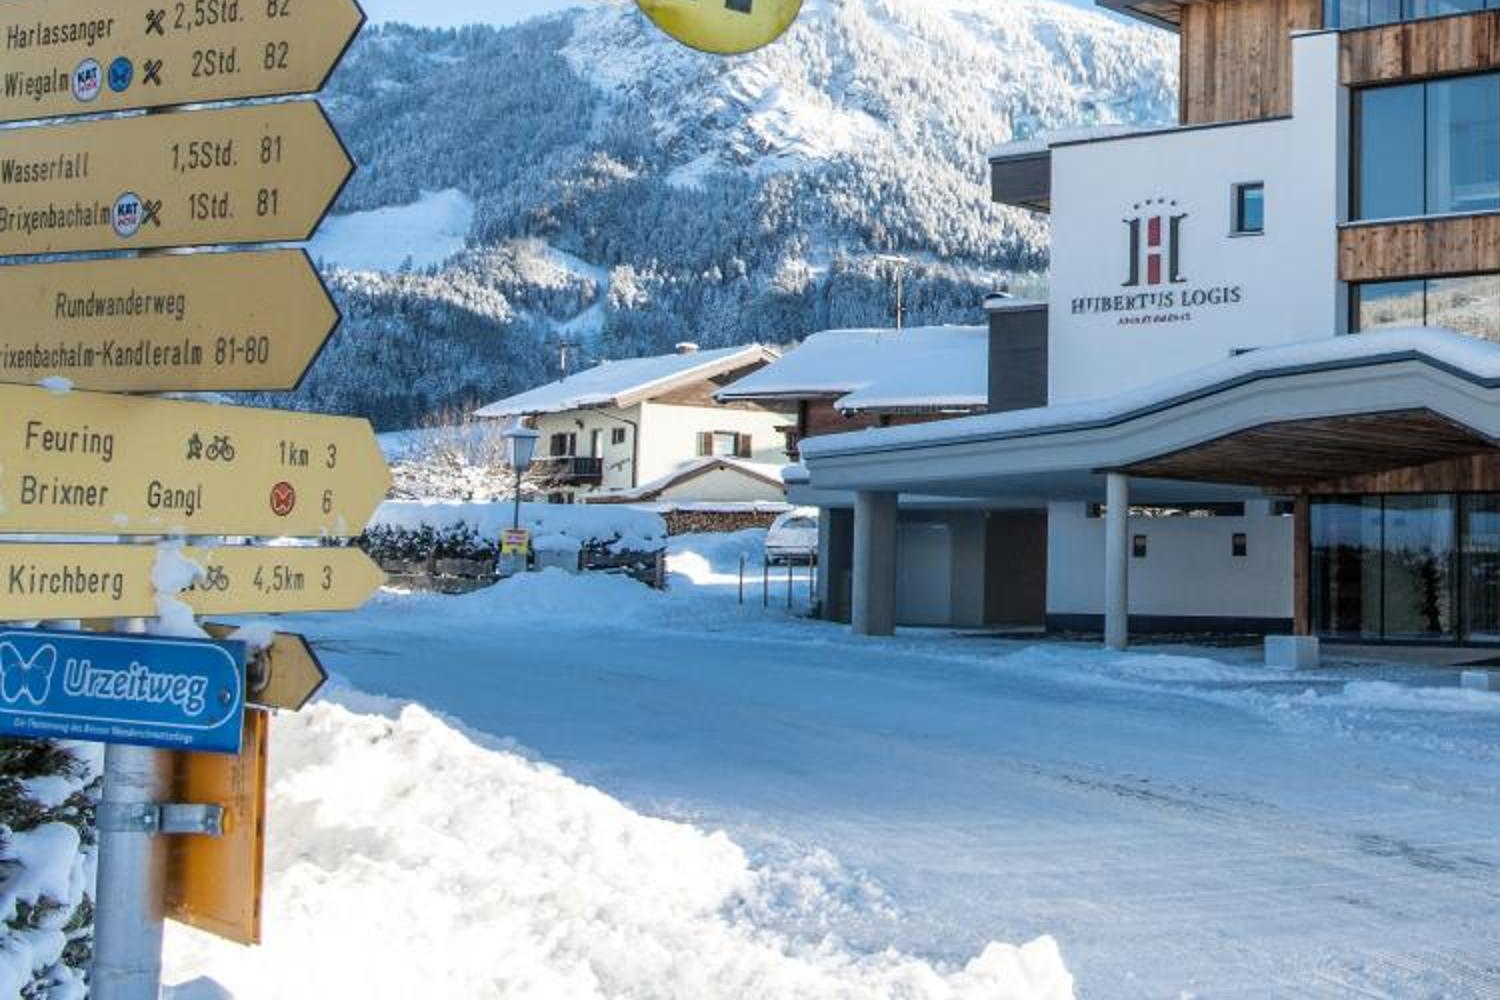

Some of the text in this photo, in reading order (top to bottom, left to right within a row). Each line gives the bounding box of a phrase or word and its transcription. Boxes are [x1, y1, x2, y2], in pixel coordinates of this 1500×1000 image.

[7, 17, 115, 49] Harlassanger
[191, 48, 241, 77] 2Std.
[264, 41, 289, 70] 82
[1, 135, 282, 184] Wasserfall 1,5Std. 81
[117, 202, 138, 216] KAT
[188, 193, 234, 220] 1Std.
[257, 188, 279, 217] 81
[54, 289, 186, 321] Rundwanderweg
[1071, 286, 1242, 315] HUBERTUS LOGIS
[0, 336, 269, 370] ixenbachalm-Kandleralm 81-80
[25, 421, 114, 463] Feuring
[325, 443, 337, 469] 3
[21, 475, 333, 517] Brixner Gangl 6
[8, 564, 333, 600] Kirchberg 4,5km 3
[63, 658, 209, 717] Urzeitweg
